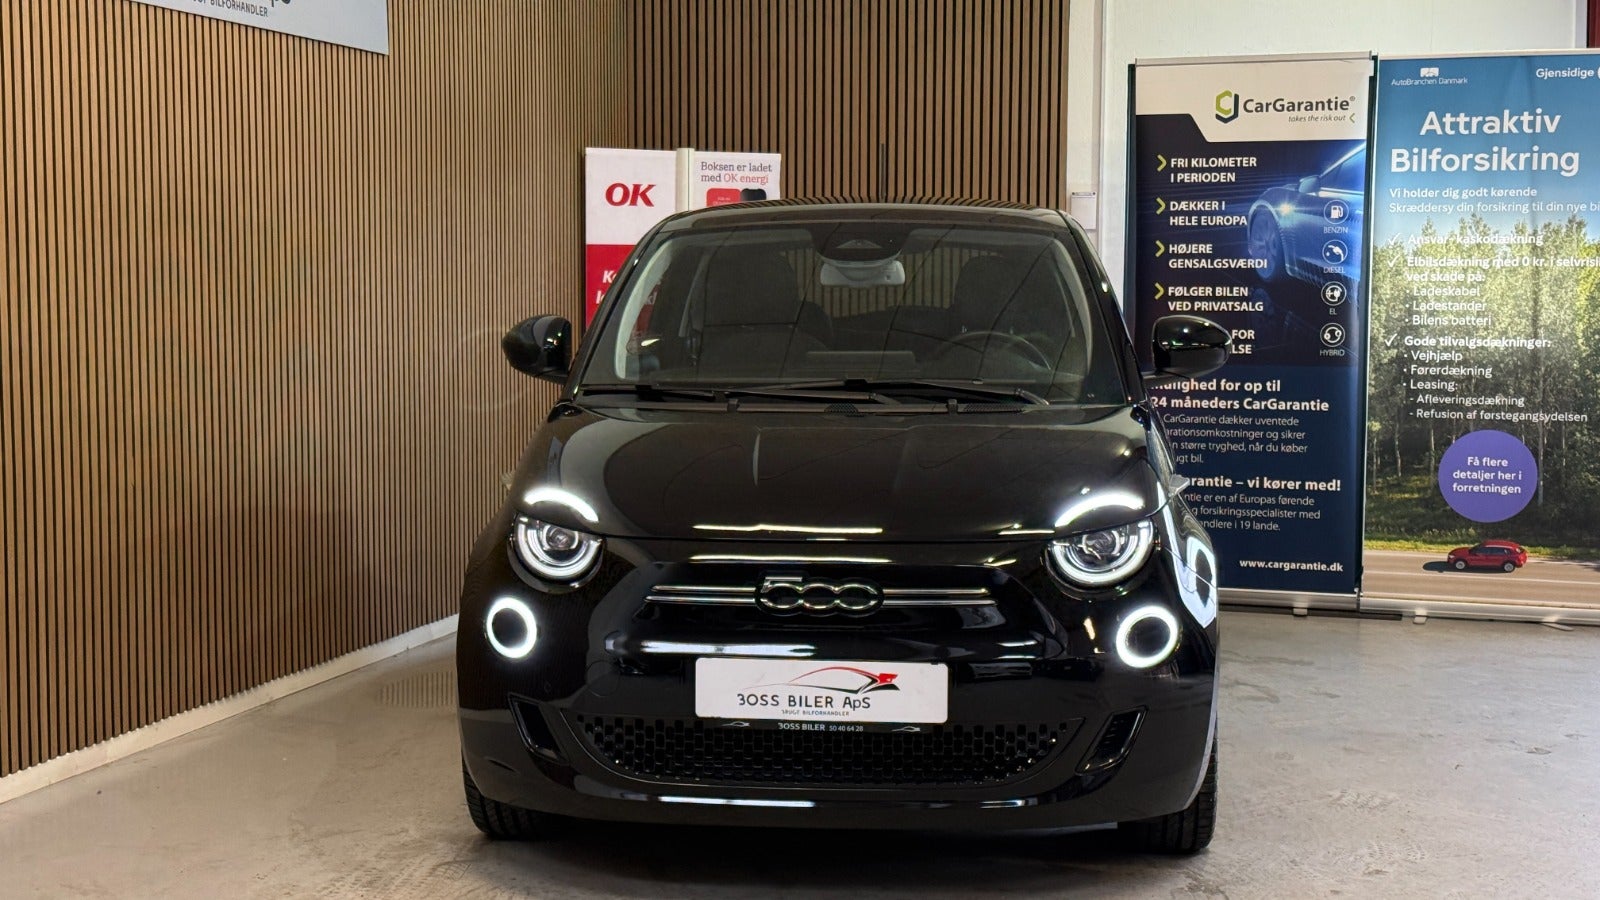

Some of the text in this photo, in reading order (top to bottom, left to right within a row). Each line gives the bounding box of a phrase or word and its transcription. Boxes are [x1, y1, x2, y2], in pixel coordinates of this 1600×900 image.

[1536, 68, 1594, 80] Gjensidige
[1420, 108, 1562, 136] Attraktiv
[700, 162, 772, 172] Boksen er ladet
[1171, 157, 1257, 168] FRI KILOMETER
[1391, 145, 1580, 177] Bilforsikring
[701, 174, 768, 185] med OK energi
[1171, 172, 1236, 183] I PERIODEN
[605, 182, 656, 207] OK
[1390, 188, 1537, 200] Vi holder dig godt kørende
[1170, 200, 1225, 211] DÆKKER I
[1390, 202, 1454, 214] Skræddersy
[1457, 202, 1474, 212] din
[1477, 200, 1528, 214] forsikring
[1532, 200, 1543, 211] til
[1546, 200, 1563, 211] din
[1566, 202, 1586, 214] nye
[1170, 216, 1247, 226] HELE EUROPA
[1170, 244, 1212, 254] HØJERE
[1169, 259, 1268, 270] GENSALGSVÆRDI
[1407, 256, 1490, 269] Elbilsdækning
[1492, 257, 1519, 268] med
[1522, 256, 1530, 266] 0
[1406, 272, 1428, 282] ved
[1431, 272, 1464, 282] skade
[1168, 286, 1248, 297] FØLGER BILEN
[1414, 286, 1480, 296] Ladeskabel
[1168, 302, 1264, 312] VED PRIVATSALG
[1413, 301, 1487, 312] Ladestander
[1412, 316, 1492, 326] Bilens batteri
[1232, 330, 1254, 340] FOR
[1404, 336, 1551, 349] Gode tilvalgsdækninger:
[1230, 344, 1252, 354] LSE
[1320, 350, 1345, 358] HYBRID
[1411, 351, 1463, 362] Vejhjælp
[1410, 365, 1492, 378] Førerdækning
[1220, 379, 1241, 391] for
[1244, 382, 1262, 394] op
[1266, 380, 1280, 392] til
[1410, 380, 1458, 392] Leasing:
[1171, 396, 1240, 409] måneders
[1244, 398, 1330, 412] CarGarantie
[1416, 395, 1525, 408] Afleveringsdækning
[1164, 414, 1299, 426] CarGarantie dækker uventede
[1416, 410, 1588, 423] Refusion af førstegangsydelsen
[1266, 431, 1278, 440] og
[1281, 430, 1306, 440] sikrer
[1181, 441, 1206, 450] større
[1208, 442, 1246, 453] tryghed,
[1249, 442, 1264, 452] når
[1266, 442, 1278, 452] du
[1281, 443, 1308, 453] køber
[1191, 454, 1204, 464] bil.
[1467, 456, 1508, 466] Få flere
[1452, 470, 1522, 482] detaljer her i
[1247, 477, 1260, 488] vi
[1264, 478, 1301, 490] kører
[1305, 479, 1341, 491] med!
[1452, 482, 1520, 496] forretningen
[1214, 494, 1226, 502] en
[1228, 493, 1238, 502] af
[1240, 494, 1276, 506] Europas
[1278, 495, 1314, 506] førende
[1200, 506, 1296, 519] forsikringsspecialister
[1299, 510, 1320, 520] med
[1240, 520, 1250, 530] 19
[1252, 522, 1280, 531] lande.
[1240, 559, 1343, 572] www.cargarantie.dk
[760, 576, 878, 610] 500
[788, 695, 833, 708] BILER
[842, 696, 871, 711] ApS
[802, 724, 825, 732] BILER
